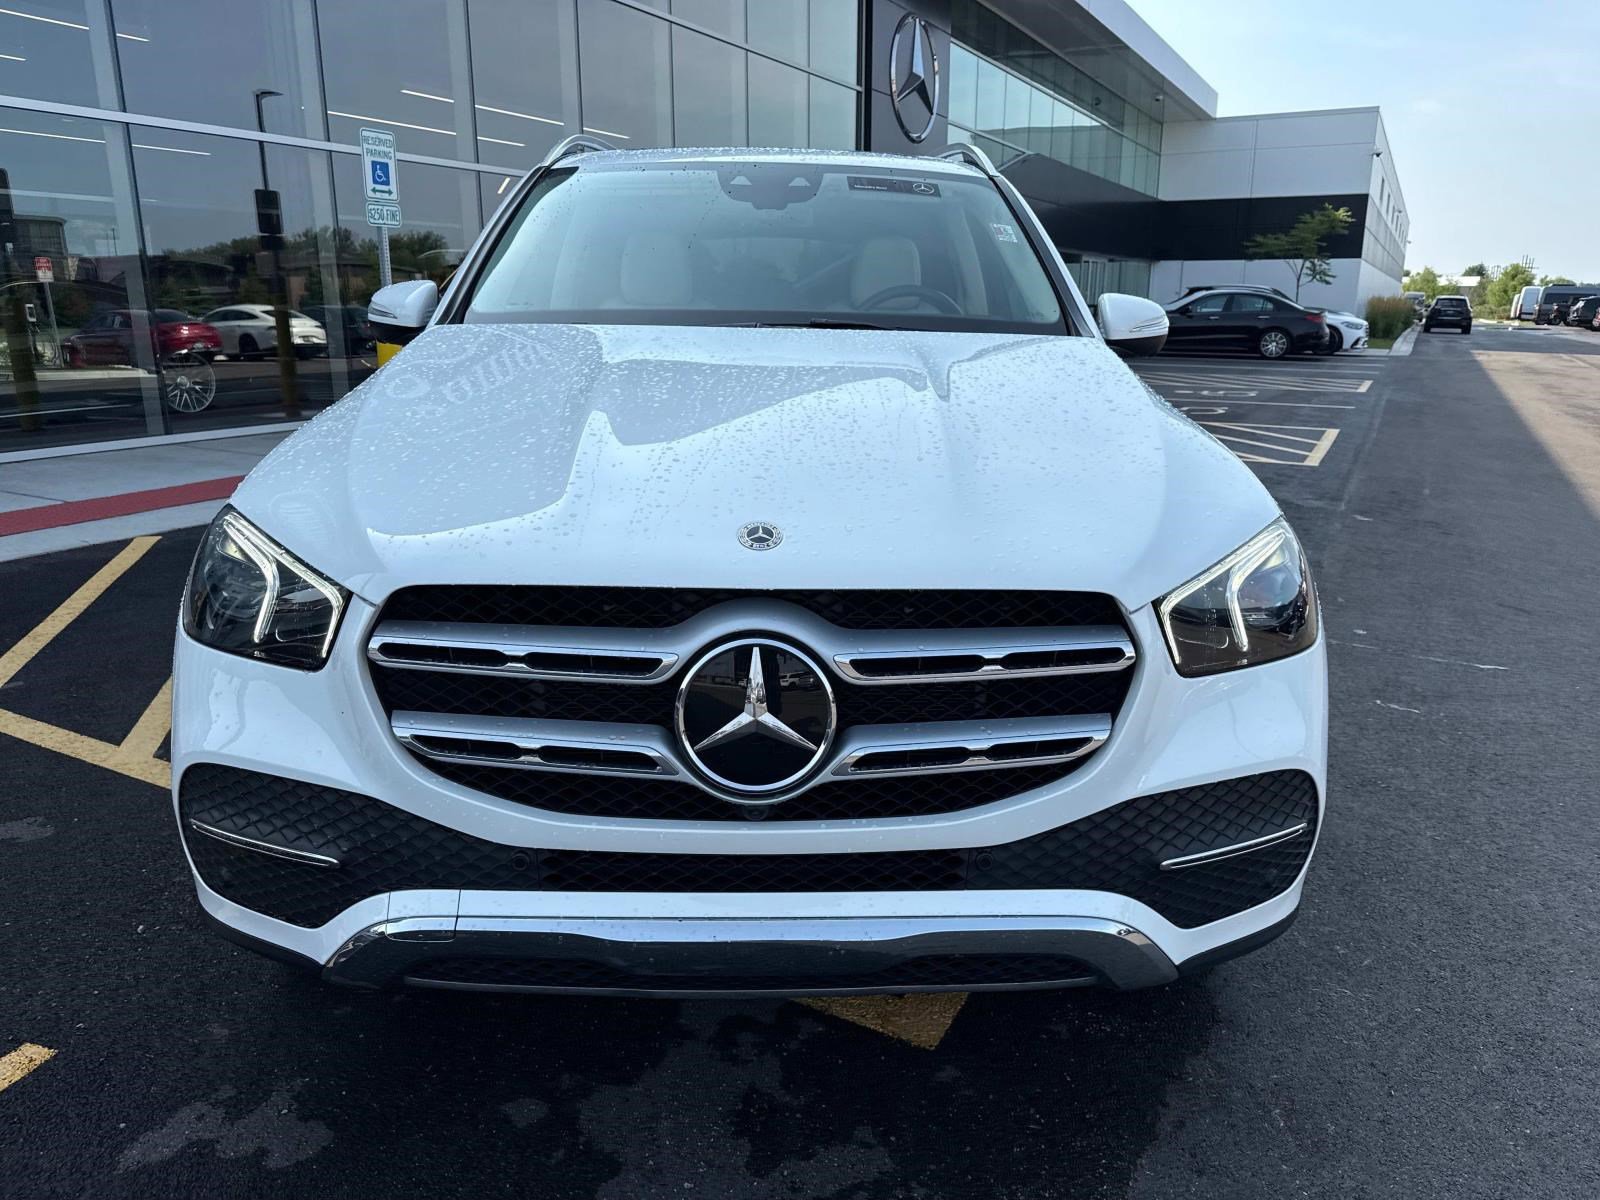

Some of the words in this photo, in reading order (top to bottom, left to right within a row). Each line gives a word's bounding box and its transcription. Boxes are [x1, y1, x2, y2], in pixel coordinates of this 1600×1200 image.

[363, 135, 393, 148] RESERVED
[365, 148, 393, 160] PARKING
[369, 208, 385, 221] $250
[386, 209, 399, 222] FINE
